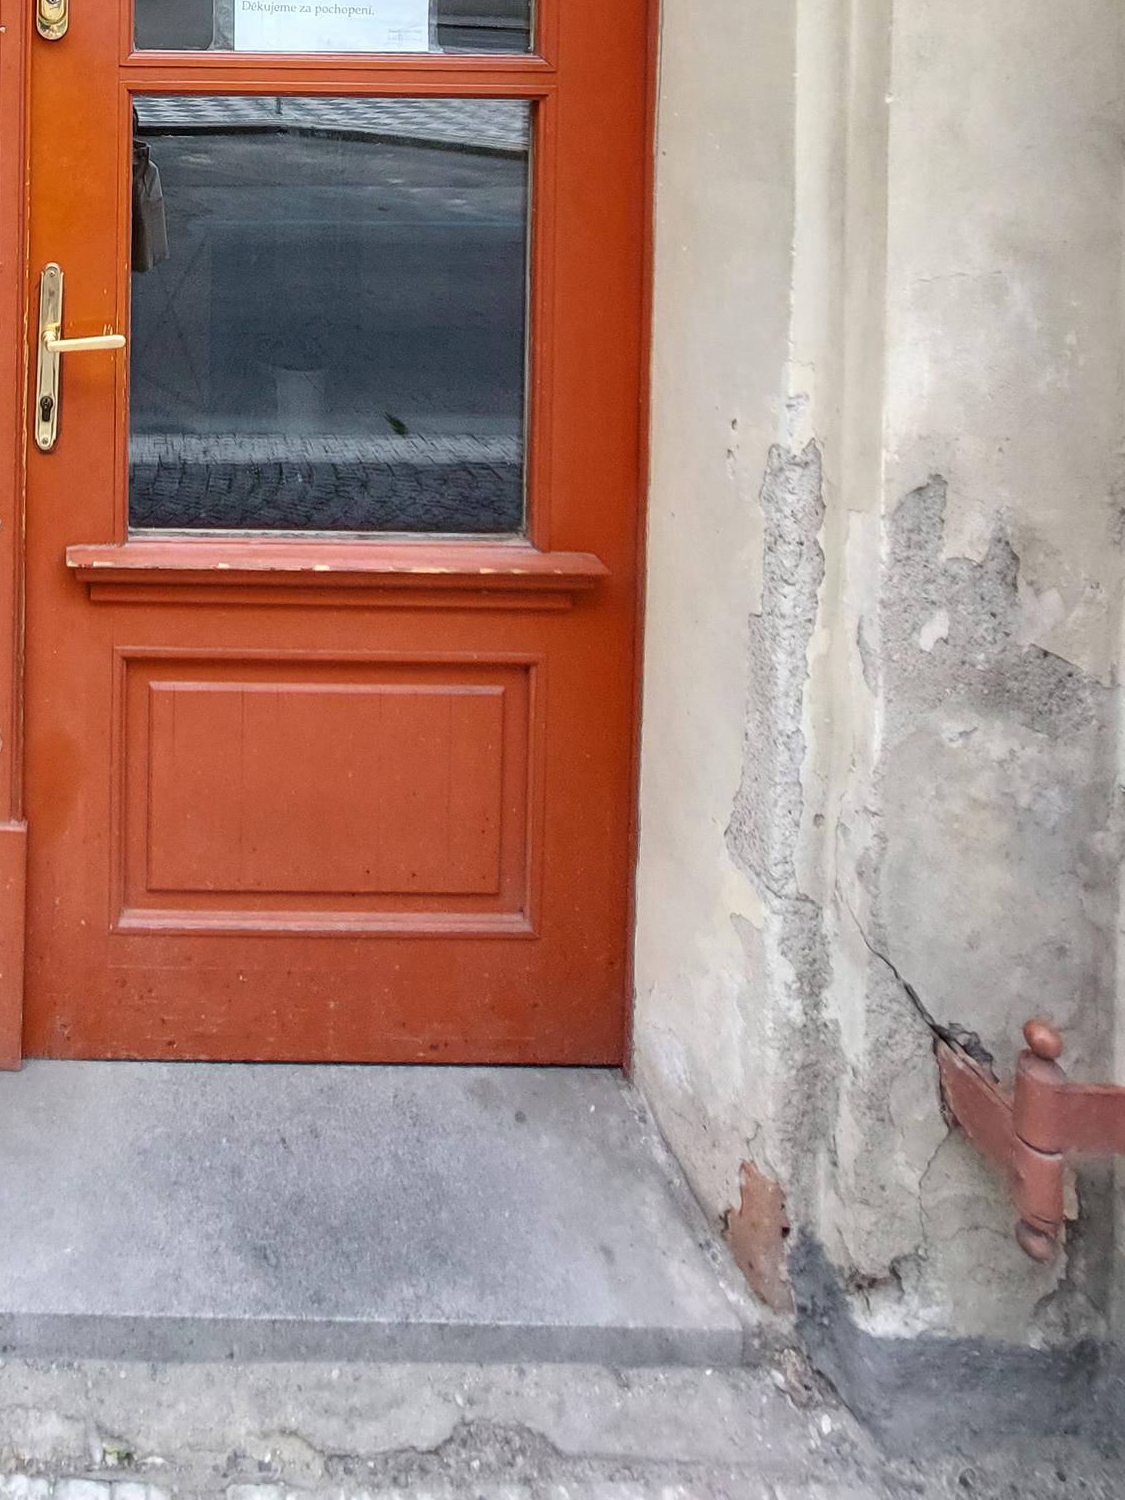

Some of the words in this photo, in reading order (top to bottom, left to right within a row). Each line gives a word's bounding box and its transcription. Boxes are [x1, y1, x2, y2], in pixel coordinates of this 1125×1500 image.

[242, 1, 297, 14] Děkujeme
[299, 4, 312, 13] za
[314, 3, 375, 17] pochopení.
